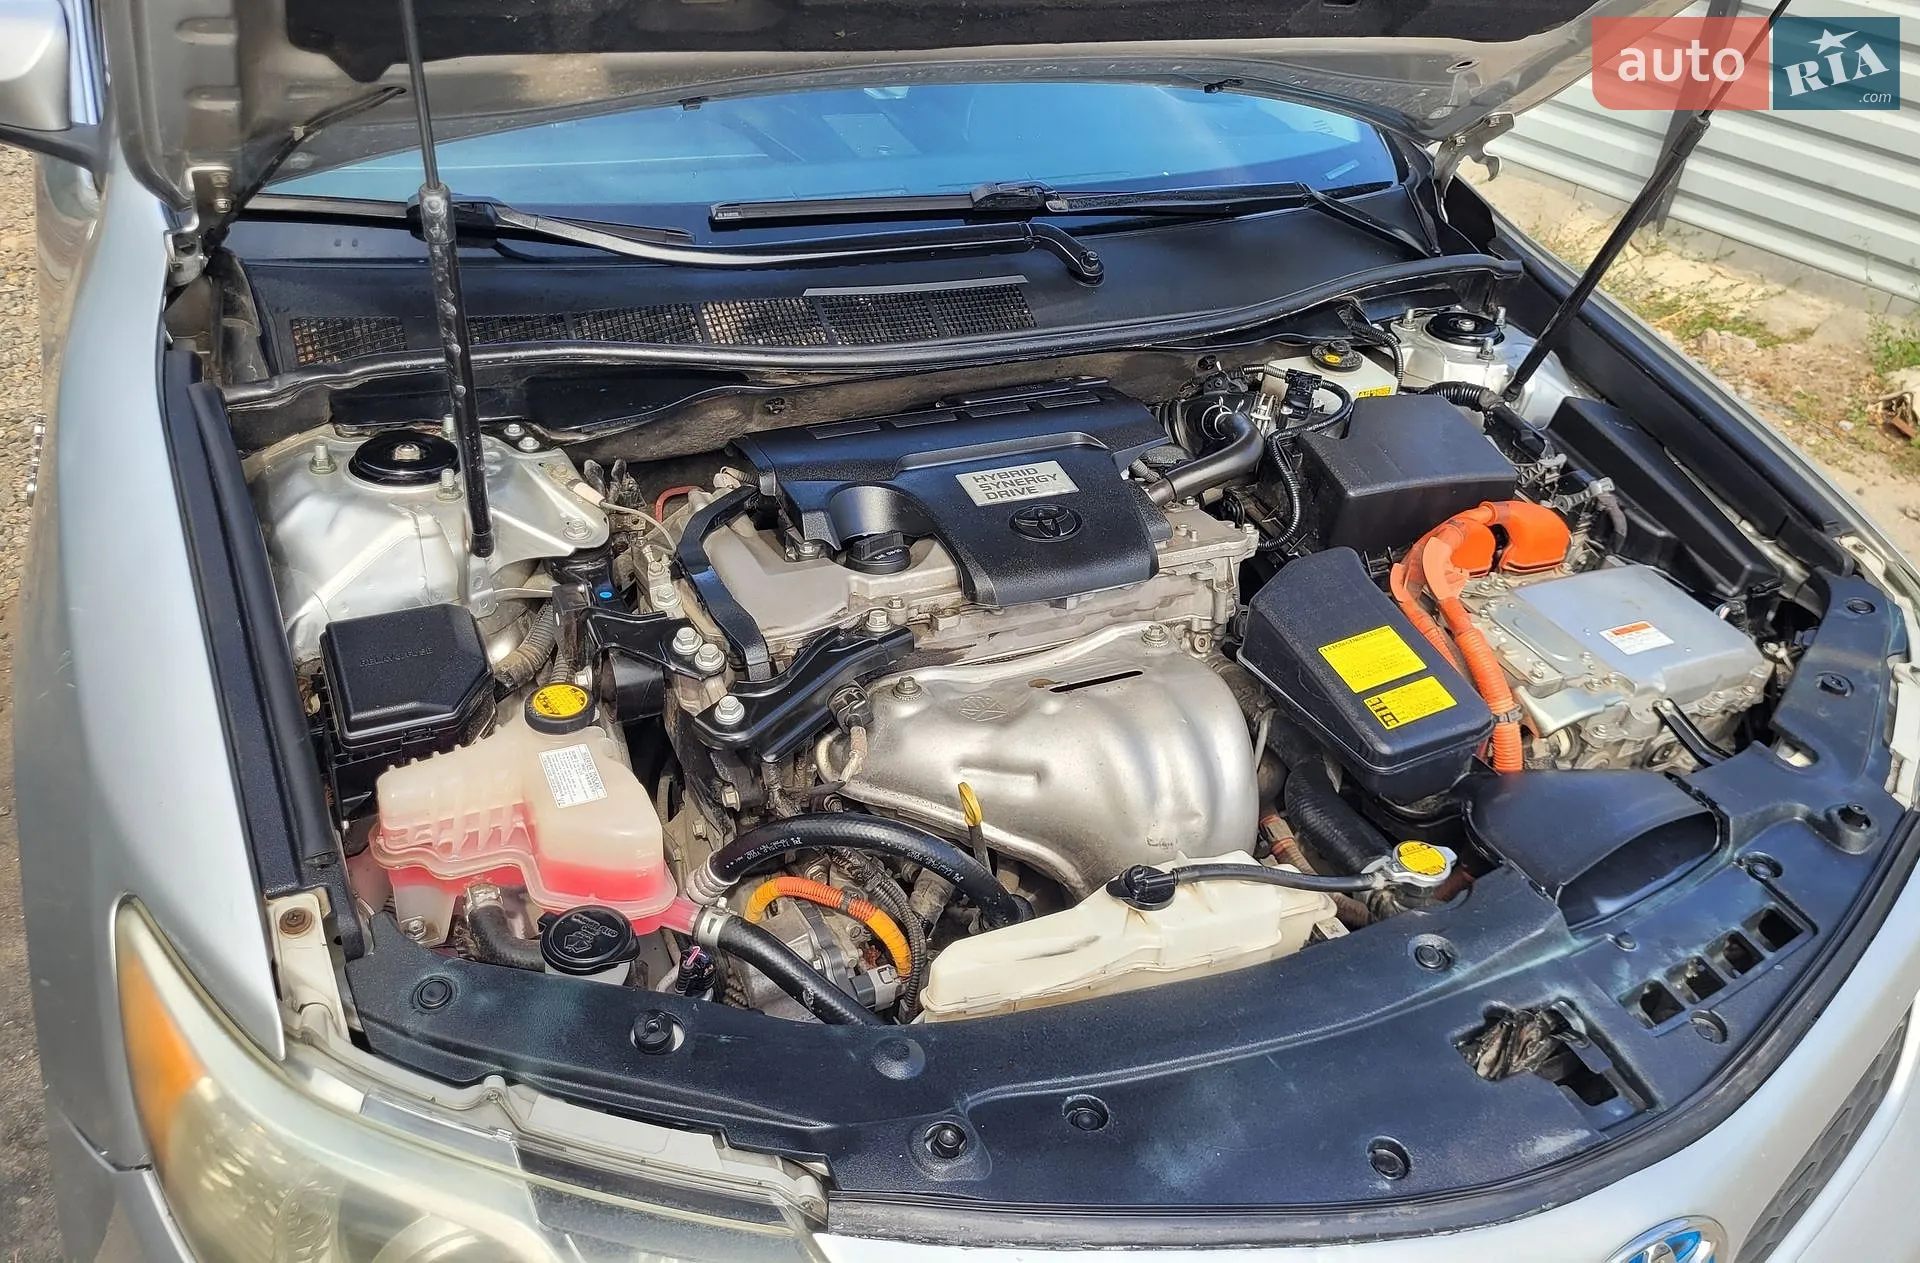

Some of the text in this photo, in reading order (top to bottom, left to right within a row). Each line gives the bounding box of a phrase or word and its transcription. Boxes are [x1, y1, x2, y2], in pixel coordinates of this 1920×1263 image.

[972, 467, 1039, 483] HYBRID
[979, 473, 1058, 492] SYNERGY
[985, 485, 1039, 500] DRIVE
